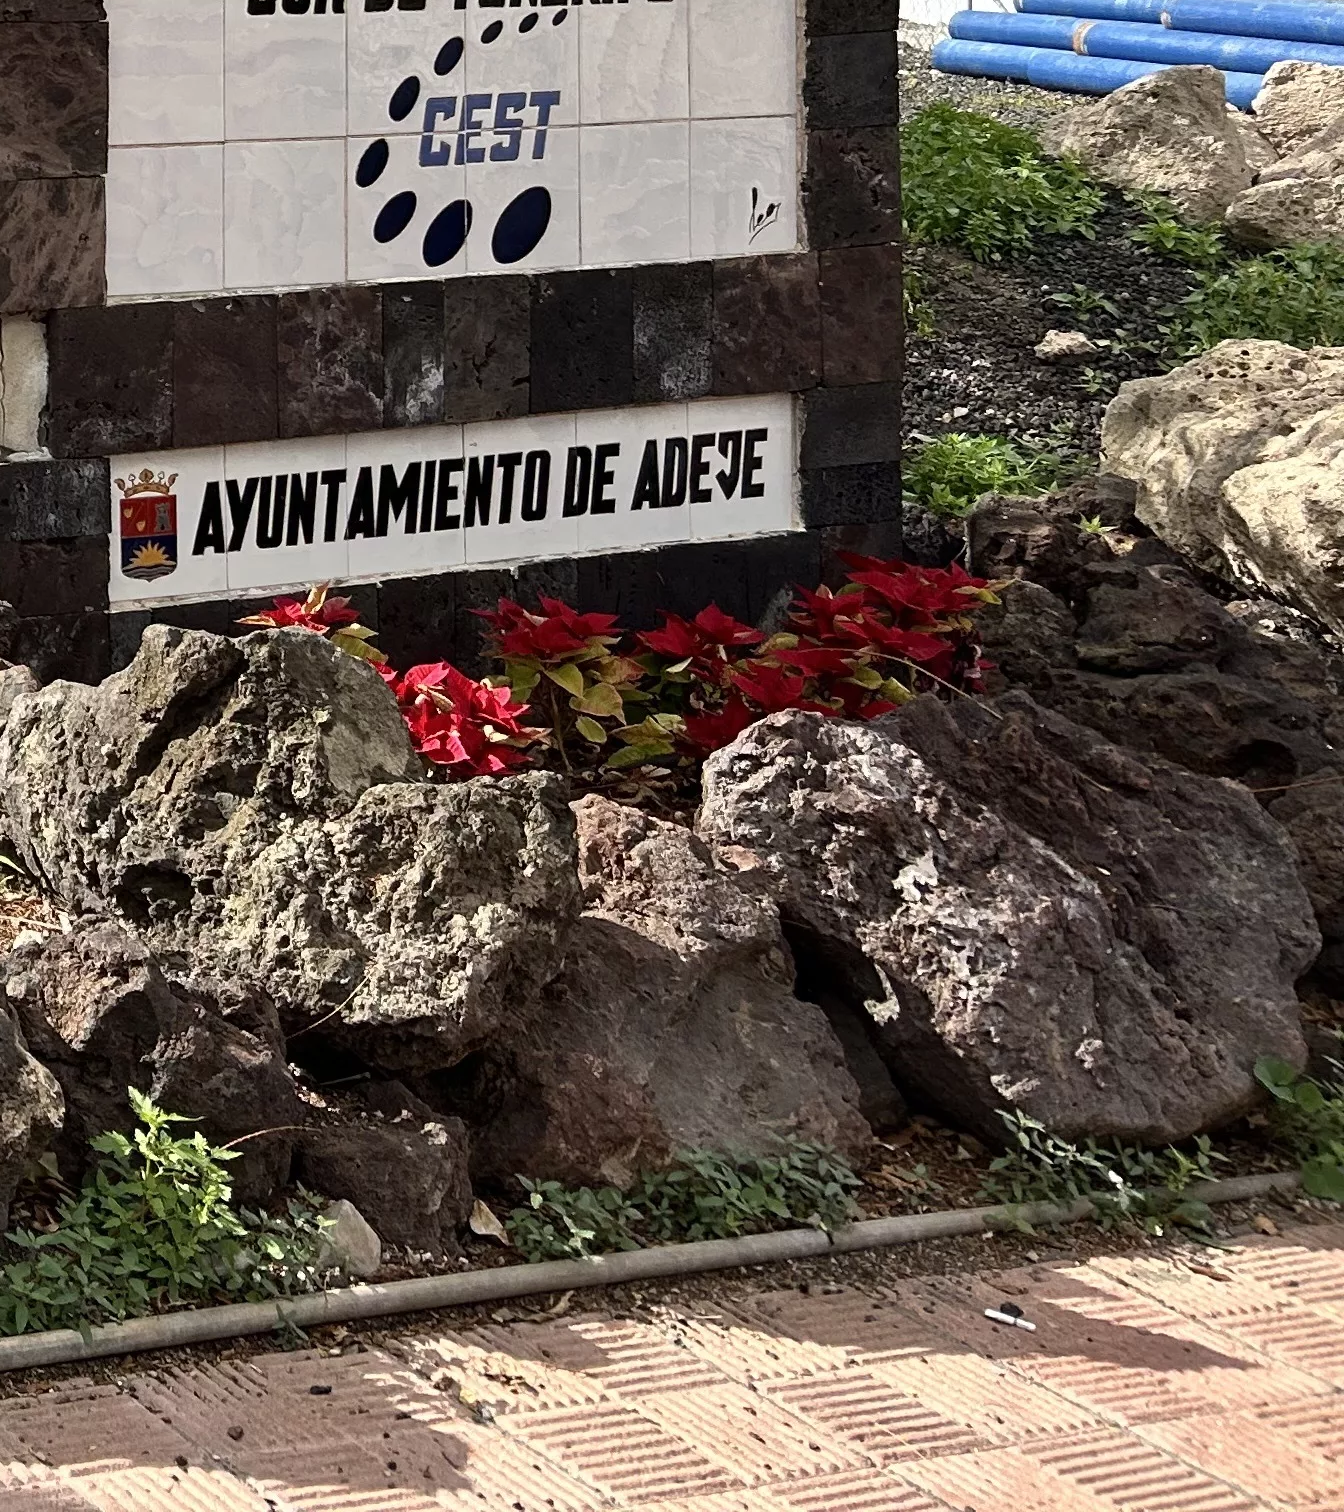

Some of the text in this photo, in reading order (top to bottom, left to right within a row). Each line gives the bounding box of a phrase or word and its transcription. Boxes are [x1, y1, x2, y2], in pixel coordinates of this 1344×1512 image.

[418, 91, 560, 168] CEST
[191, 427, 768, 556] AYUNTAMIENTO DE ADEJE
